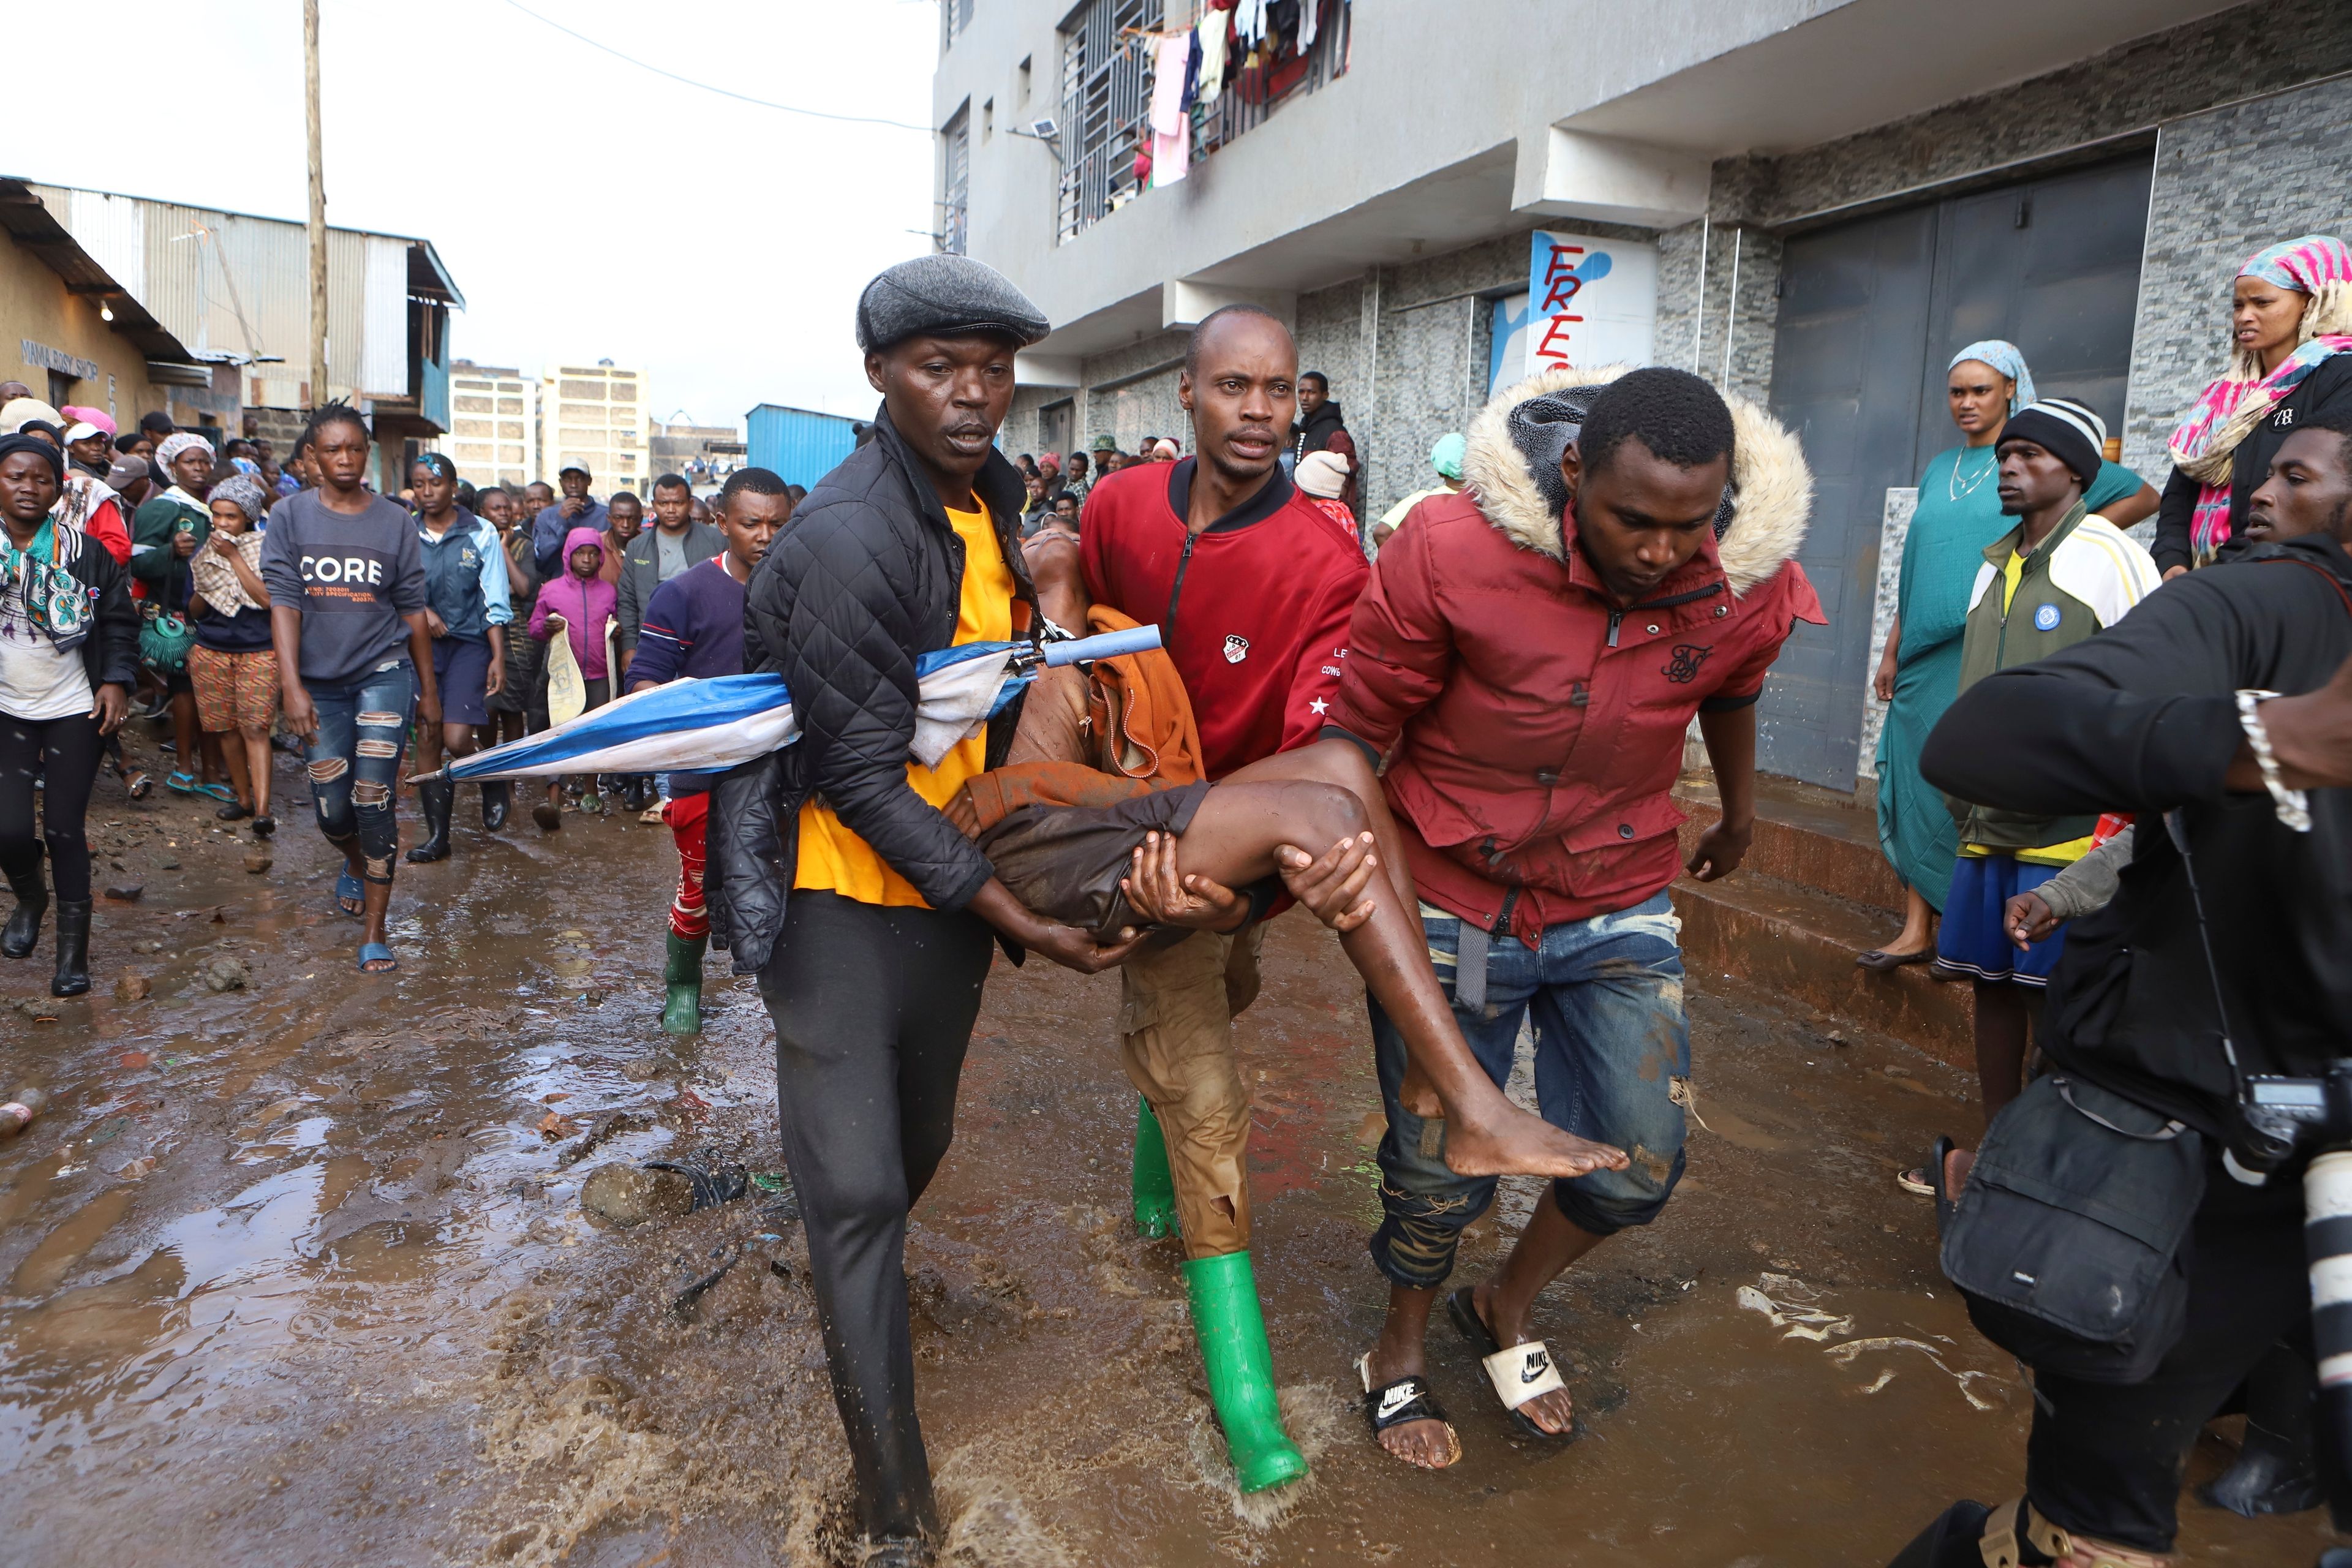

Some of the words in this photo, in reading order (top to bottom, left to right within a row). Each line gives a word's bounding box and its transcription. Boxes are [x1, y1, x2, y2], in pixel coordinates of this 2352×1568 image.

[1536, 245, 1584, 373] FRE
[21, 339, 51, 368] MAMA
[53, 349, 73, 374] ROSY
[76, 359, 98, 382] SHOP
[300, 556, 382, 586] CORE
[1526, 1351, 1548, 1370] NIKE
[1384, 1383, 1415, 1406] NIKE
